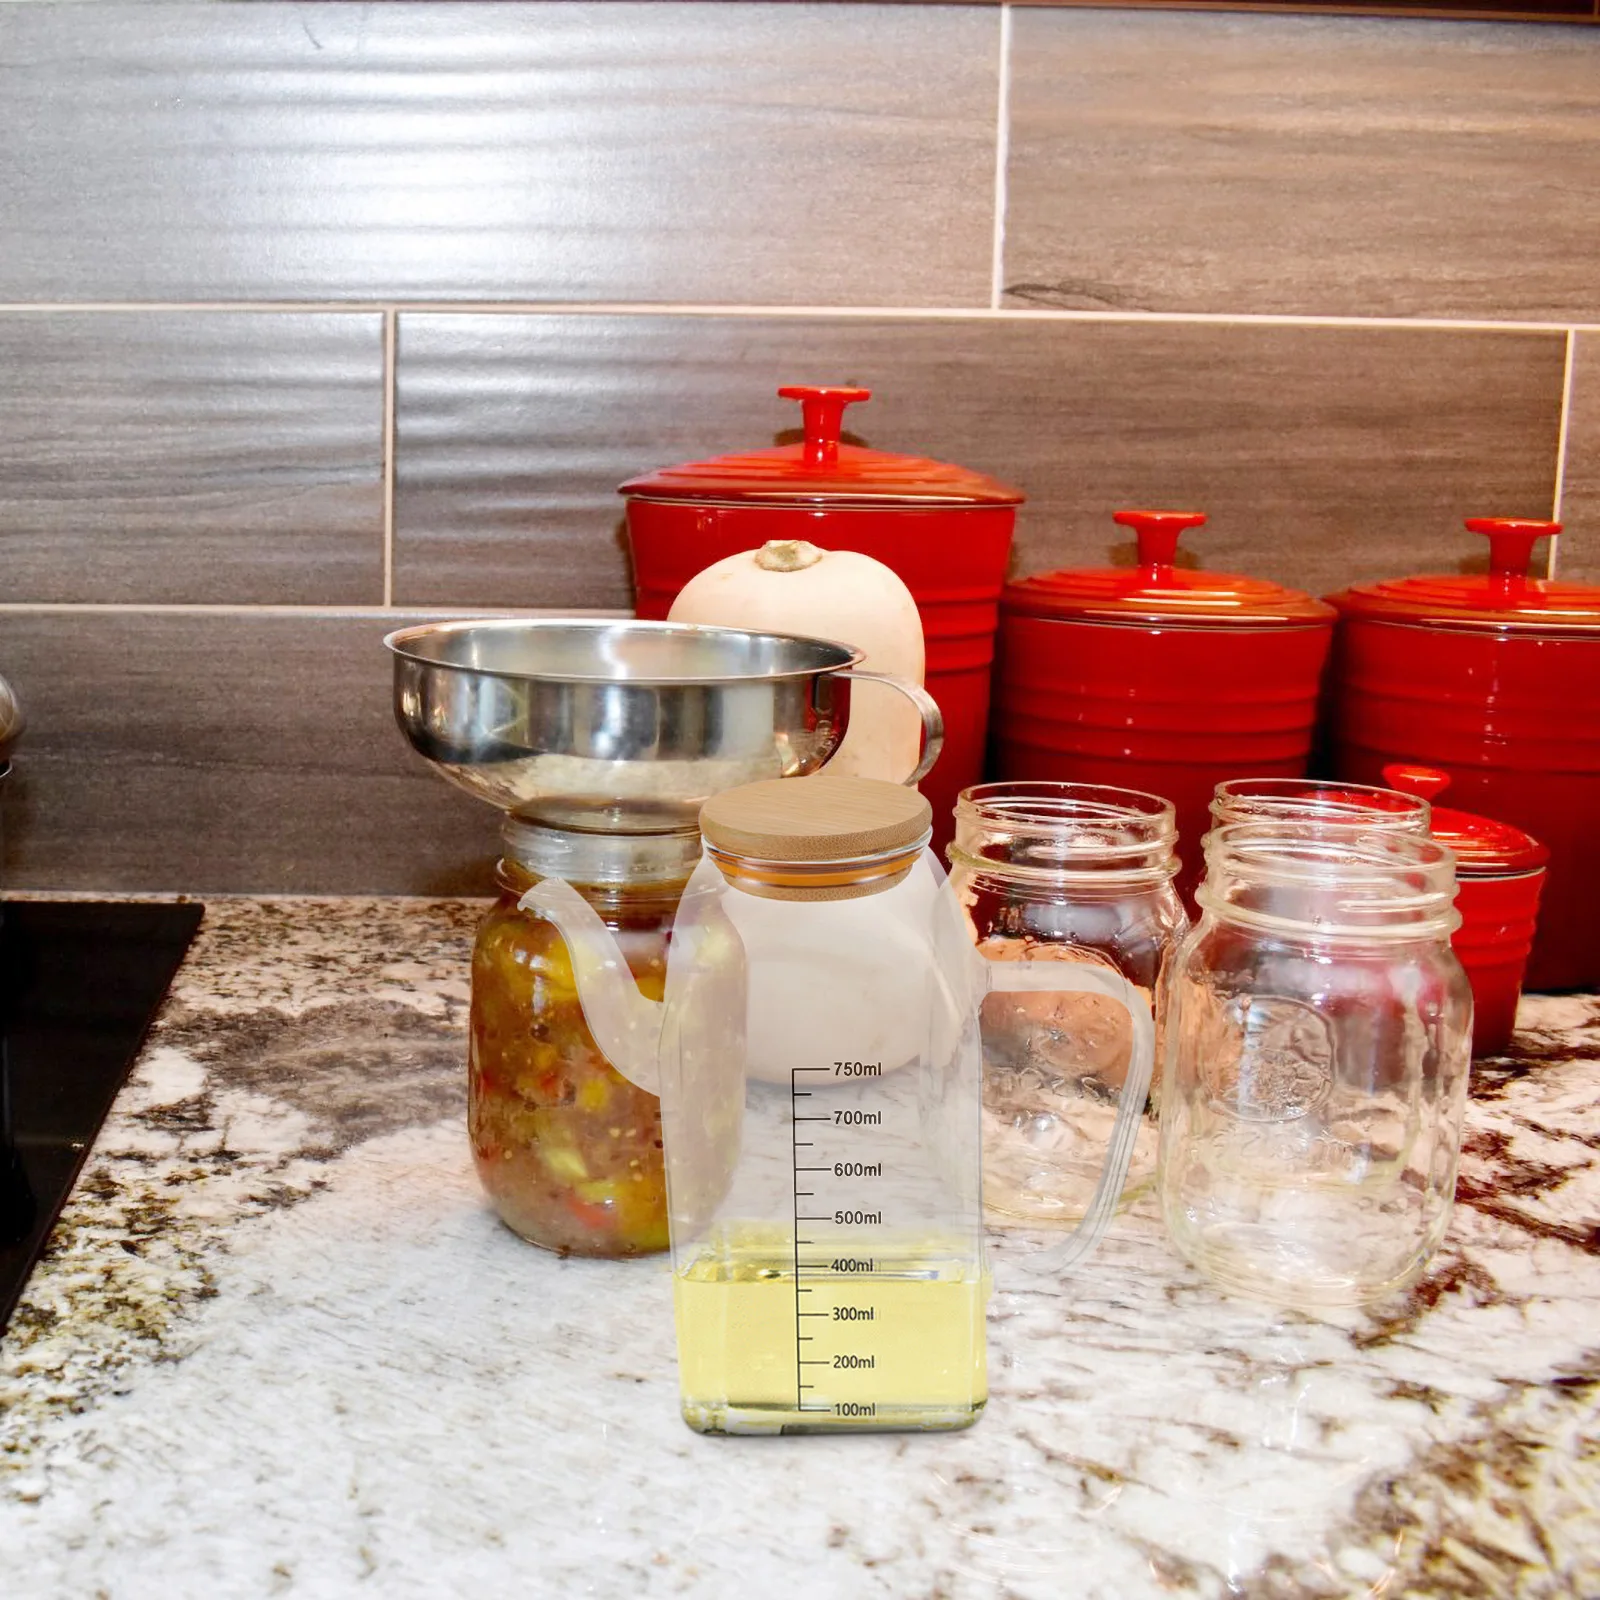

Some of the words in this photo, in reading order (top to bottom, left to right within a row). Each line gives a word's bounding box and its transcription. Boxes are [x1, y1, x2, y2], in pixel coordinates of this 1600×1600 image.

[833, 1062, 882, 1076] 750ml
[833, 1110, 882, 1125] 700ml
[834, 1163, 882, 1177] 600ml
[834, 1211, 882, 1224] 500ml
[830, 1258, 874, 1272] 400ml
[832, 1307, 874, 1320] 300ml
[833, 1355, 875, 1368] 200ml
[834, 1403, 876, 1416] 100ml
